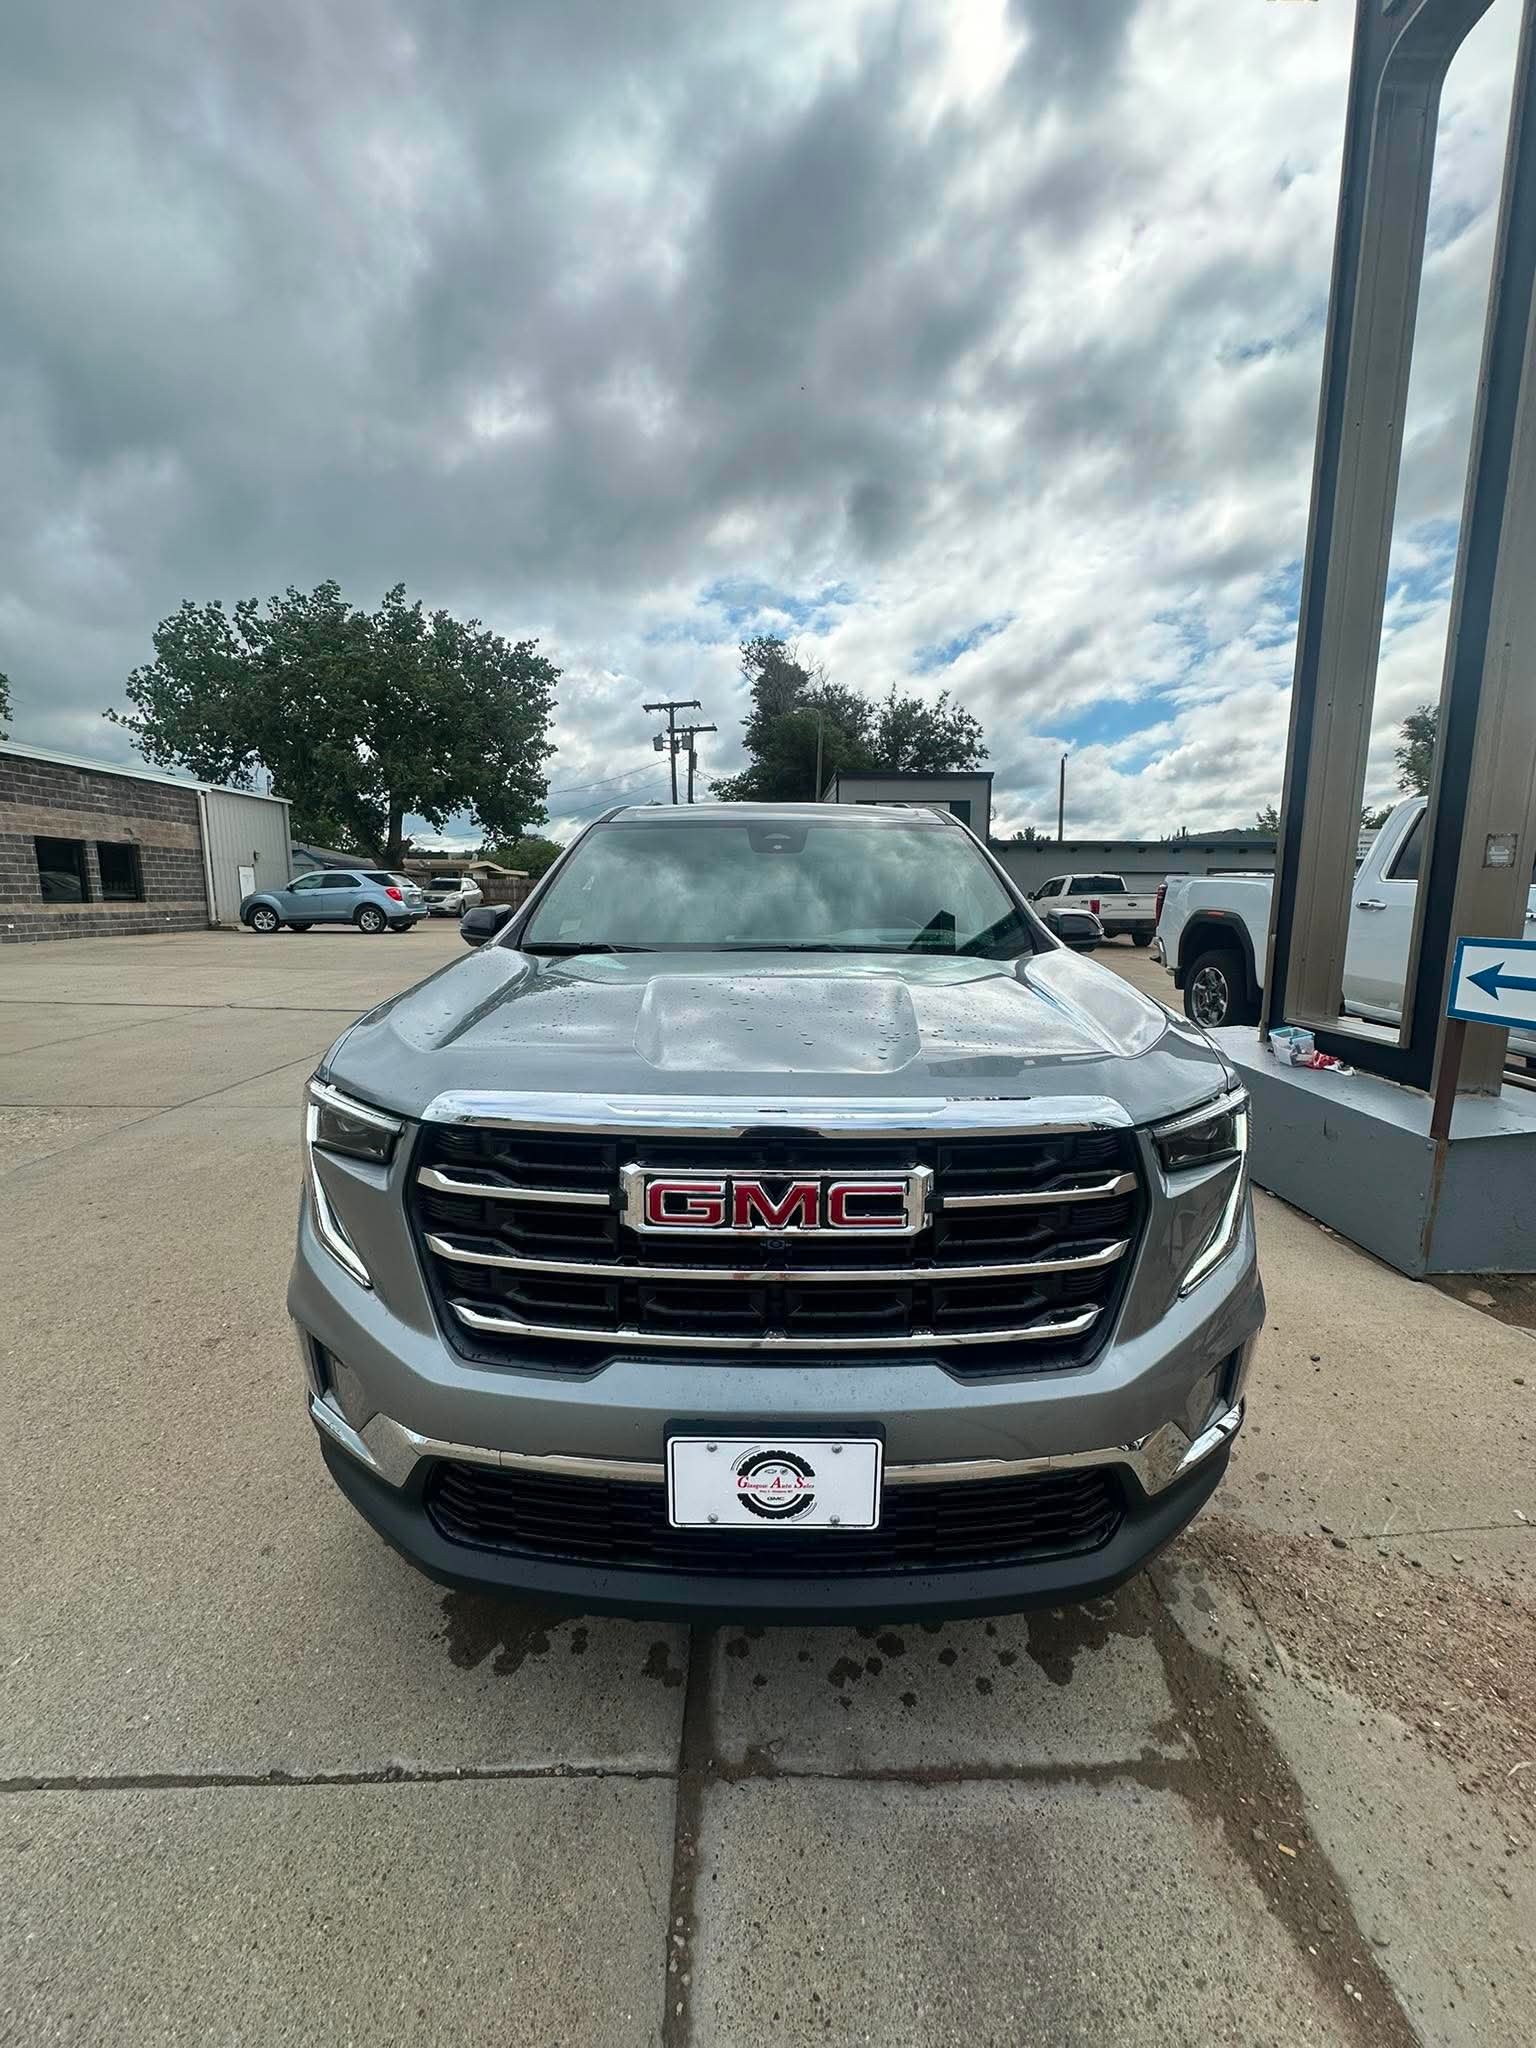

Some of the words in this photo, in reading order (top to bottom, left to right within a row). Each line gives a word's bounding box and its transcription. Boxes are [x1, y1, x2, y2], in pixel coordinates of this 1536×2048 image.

[646, 1180, 907, 1229] GMC
[770, 1476, 792, 1489] Auto
[794, 1475, 814, 1489] Sales
